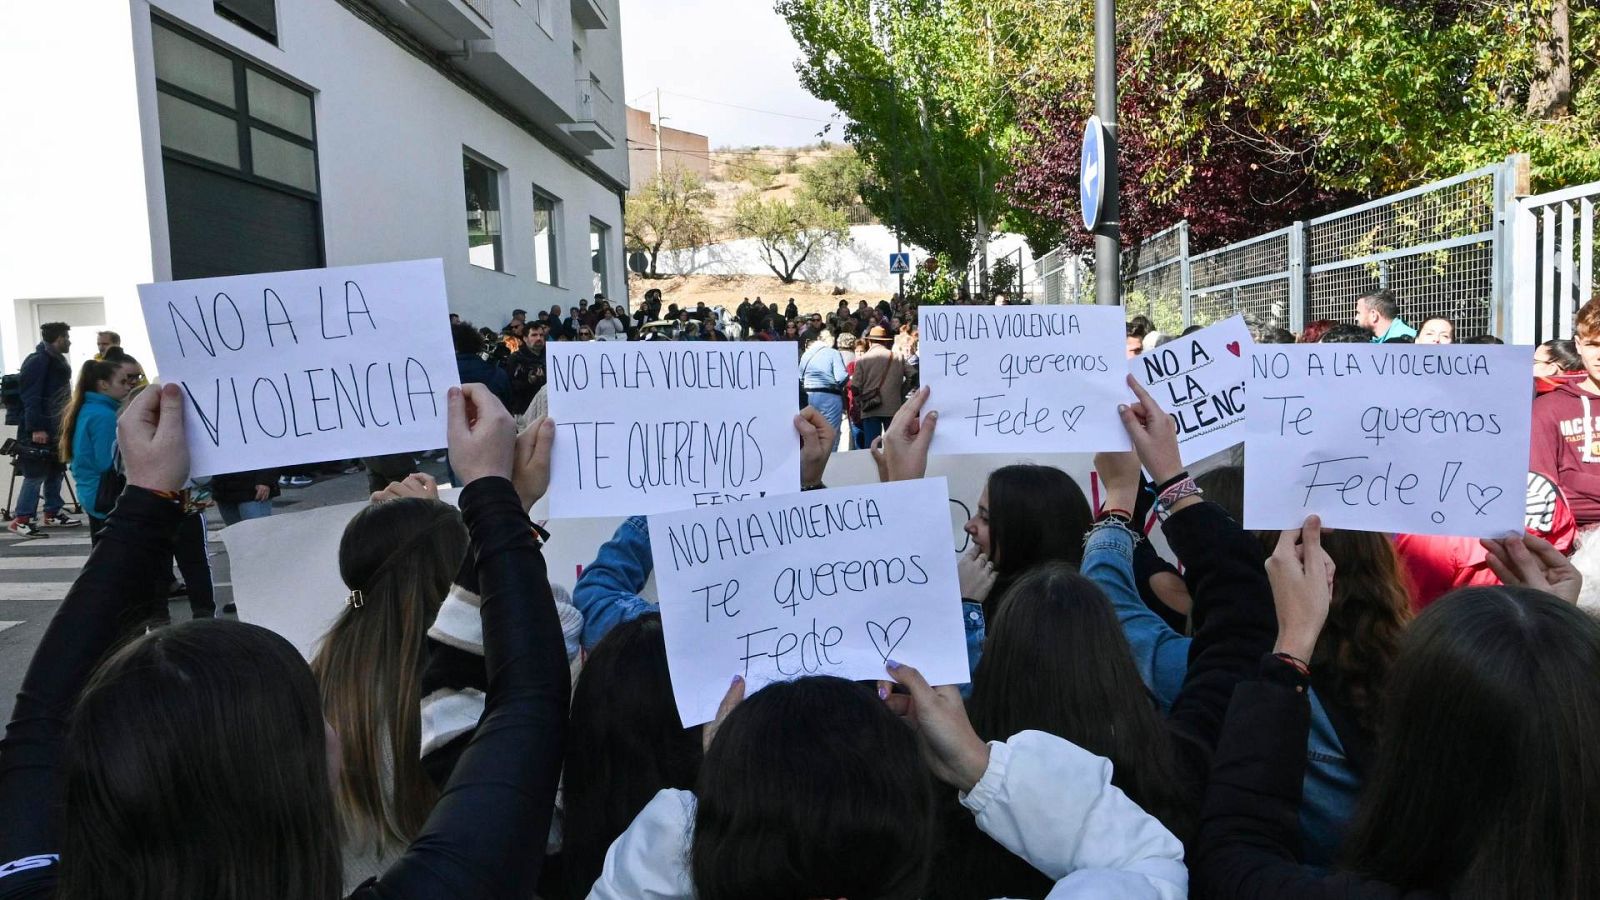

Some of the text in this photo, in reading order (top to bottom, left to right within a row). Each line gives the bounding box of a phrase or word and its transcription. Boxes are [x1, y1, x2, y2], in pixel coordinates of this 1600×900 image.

[168, 280, 376, 357] NO A LA
[925, 312, 949, 342] NO
[993, 313, 1081, 340] VIOLENCIA
[552, 353, 589, 392] NO
[659, 350, 777, 390] VIOLENCIA
[935, 351, 1108, 388] Te queremos
[1142, 339, 1210, 385] NO A
[1252, 352, 1290, 380] NO
[1307, 352, 1325, 377] A
[1333, 352, 1362, 377] LA
[181, 356, 437, 447] VIOLENCIA
[1168, 374, 1206, 404] LA
[965, 394, 1055, 437] Fede
[1263, 395, 1502, 445] Te queremos
[556, 416, 764, 494] TE QUEREMOS
[668, 522, 709, 571] NO
[691, 554, 929, 623] Te queremos
[736, 617, 844, 677] Fede
